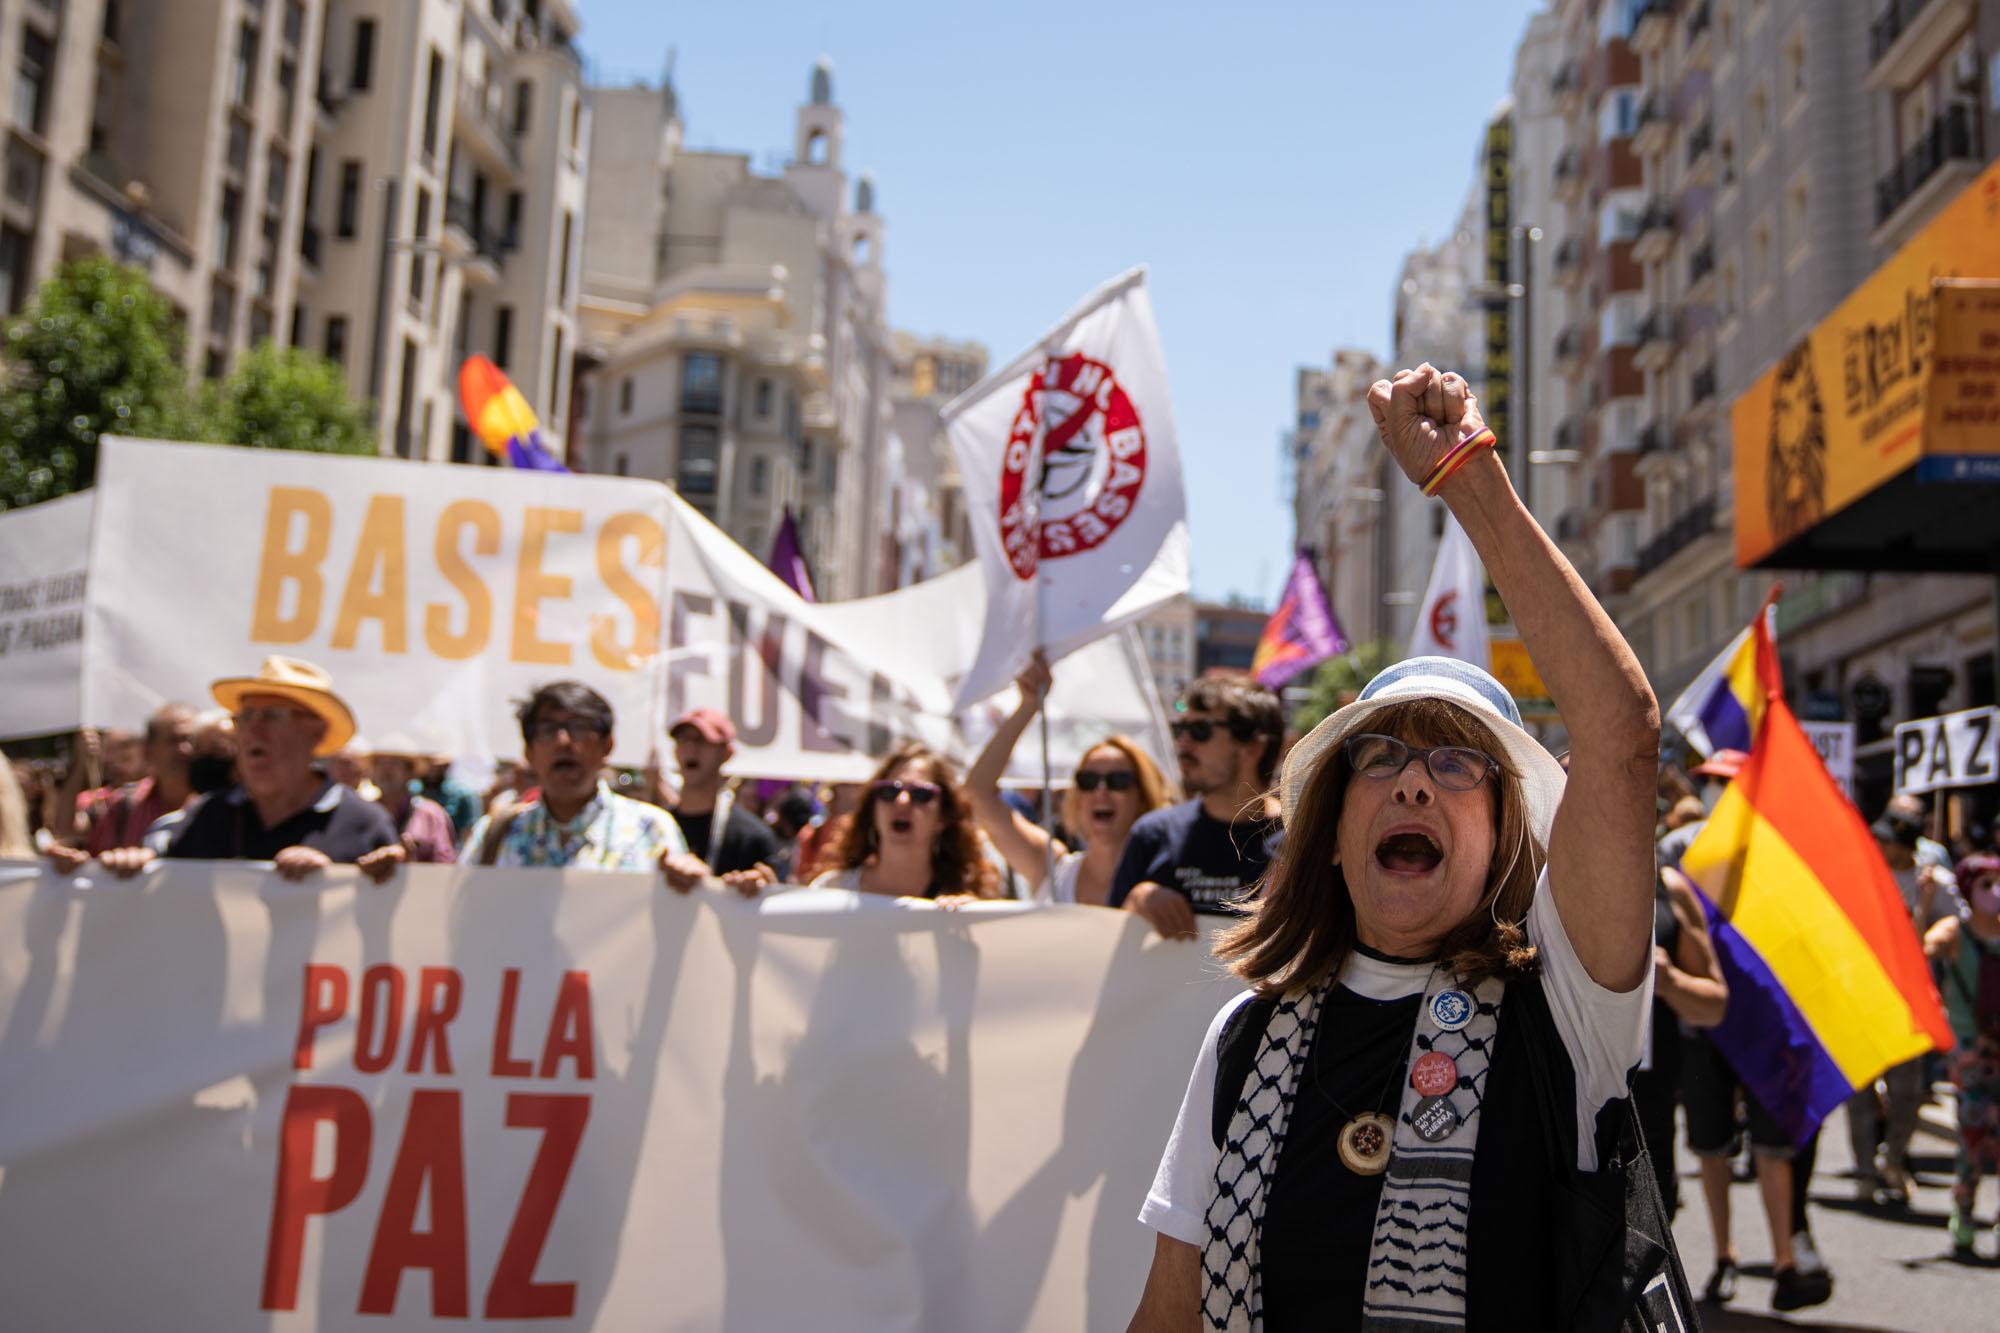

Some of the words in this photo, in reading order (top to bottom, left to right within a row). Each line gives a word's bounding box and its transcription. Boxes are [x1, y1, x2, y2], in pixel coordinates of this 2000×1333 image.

[1042, 426, 1144, 555] BASES
[249, 485, 668, 672] BASES
[1901, 714, 1991, 789] PAZ
[292, 962, 464, 1076] POR
[490, 968, 596, 1080] LA
[1415, 1110, 1431, 1126] OTRA
[1430, 1098, 1444, 1111] VEZ
[1420, 1120, 1429, 1130] NO
[1435, 1108, 1445, 1117] LA
[1424, 1110, 1454, 1137] GUERRA
[259, 1083, 593, 1321] PAZ
